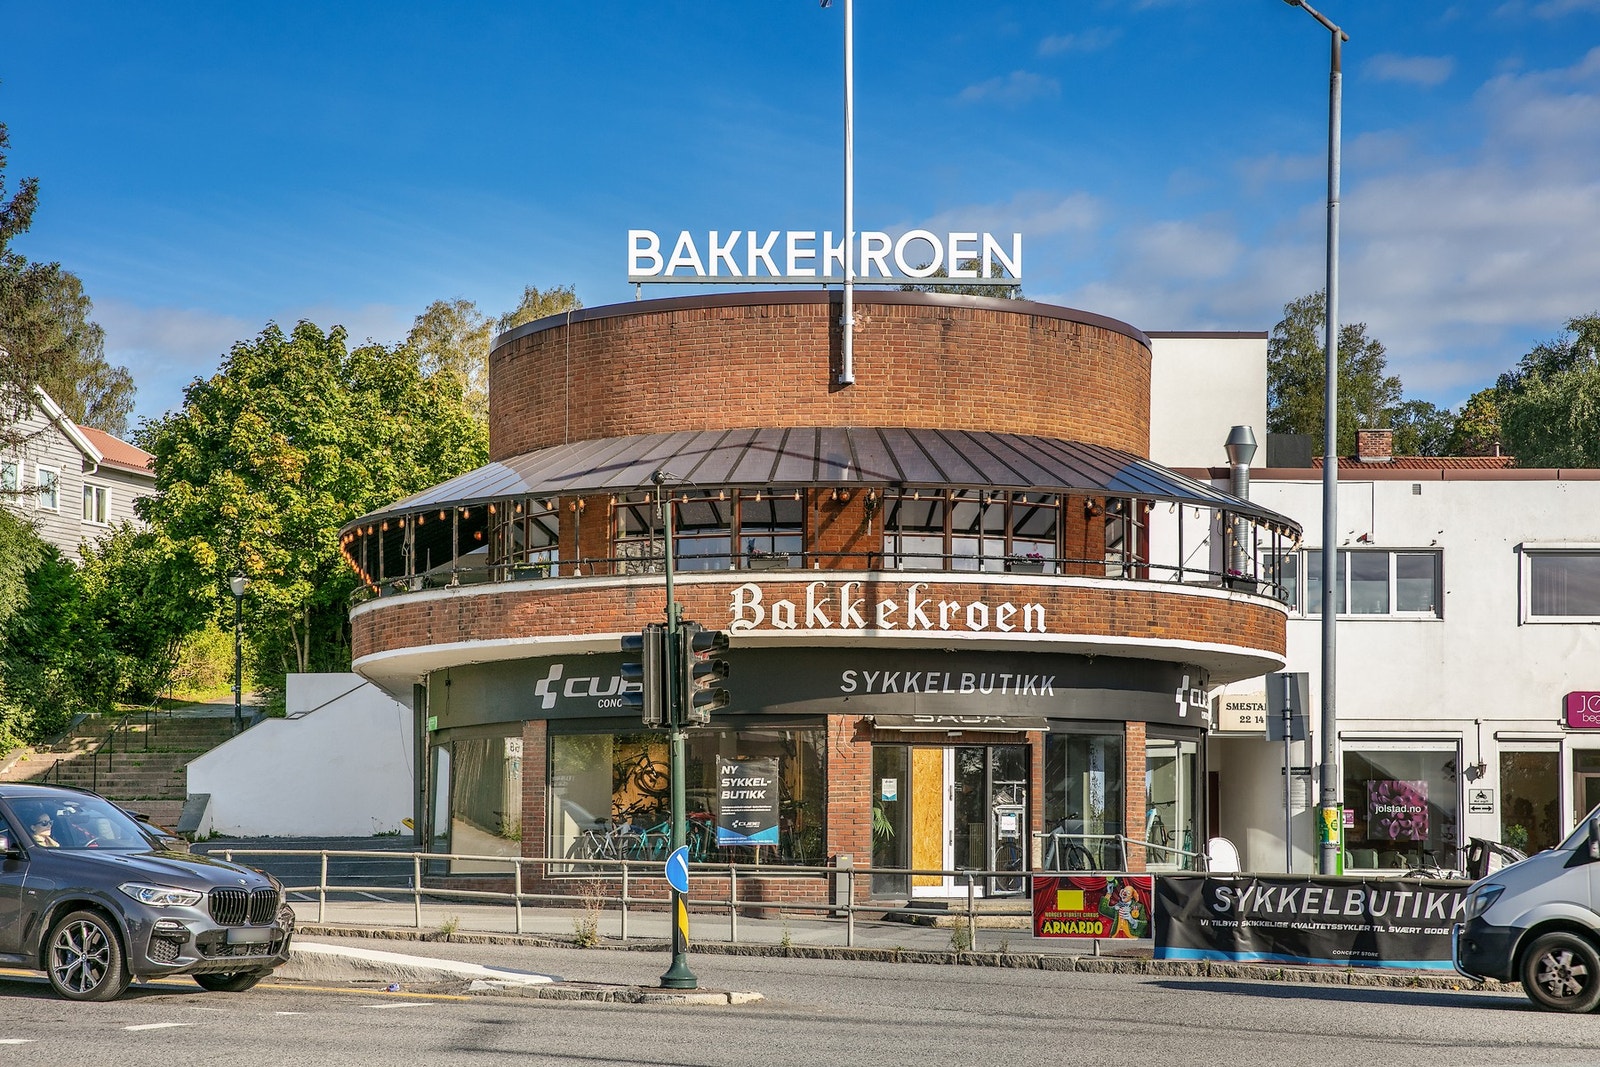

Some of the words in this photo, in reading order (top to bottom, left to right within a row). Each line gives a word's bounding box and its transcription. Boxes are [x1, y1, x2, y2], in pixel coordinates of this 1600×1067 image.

[628, 229, 1022, 278] BAKKEKROEN
[730, 581, 1047, 635] Bakkekroen
[840, 670, 1056, 697] SYKKELBUTIKK
[597, 698, 623, 709] CONC
[1225, 702, 1266, 711] SMESTA
[1239, 715, 1252, 724] 22
[1255, 715, 1265, 724] 14
[721, 765, 738, 775] NY
[721, 778, 772, 787] SYKKEL-
[721, 790, 766, 799] BUTIKK
[1375, 804, 1422, 815] jolstad.no
[1212, 886, 1468, 920] SYKKELBUTIKK
[1043, 921, 1103, 935] ARNARDO
[1212, 919, 1239, 927] TILBYR
[1241, 920, 1289, 929] SKIKKELIGE
[1291, 921, 1371, 932] KVALITETSSYKLER
[1373, 925, 1385, 933] TIL
[1388, 926, 1421, 934] SVÆRT
[1424, 927, 1449, 935] GODE
[1332, 949, 1360, 957] CONCEPT
